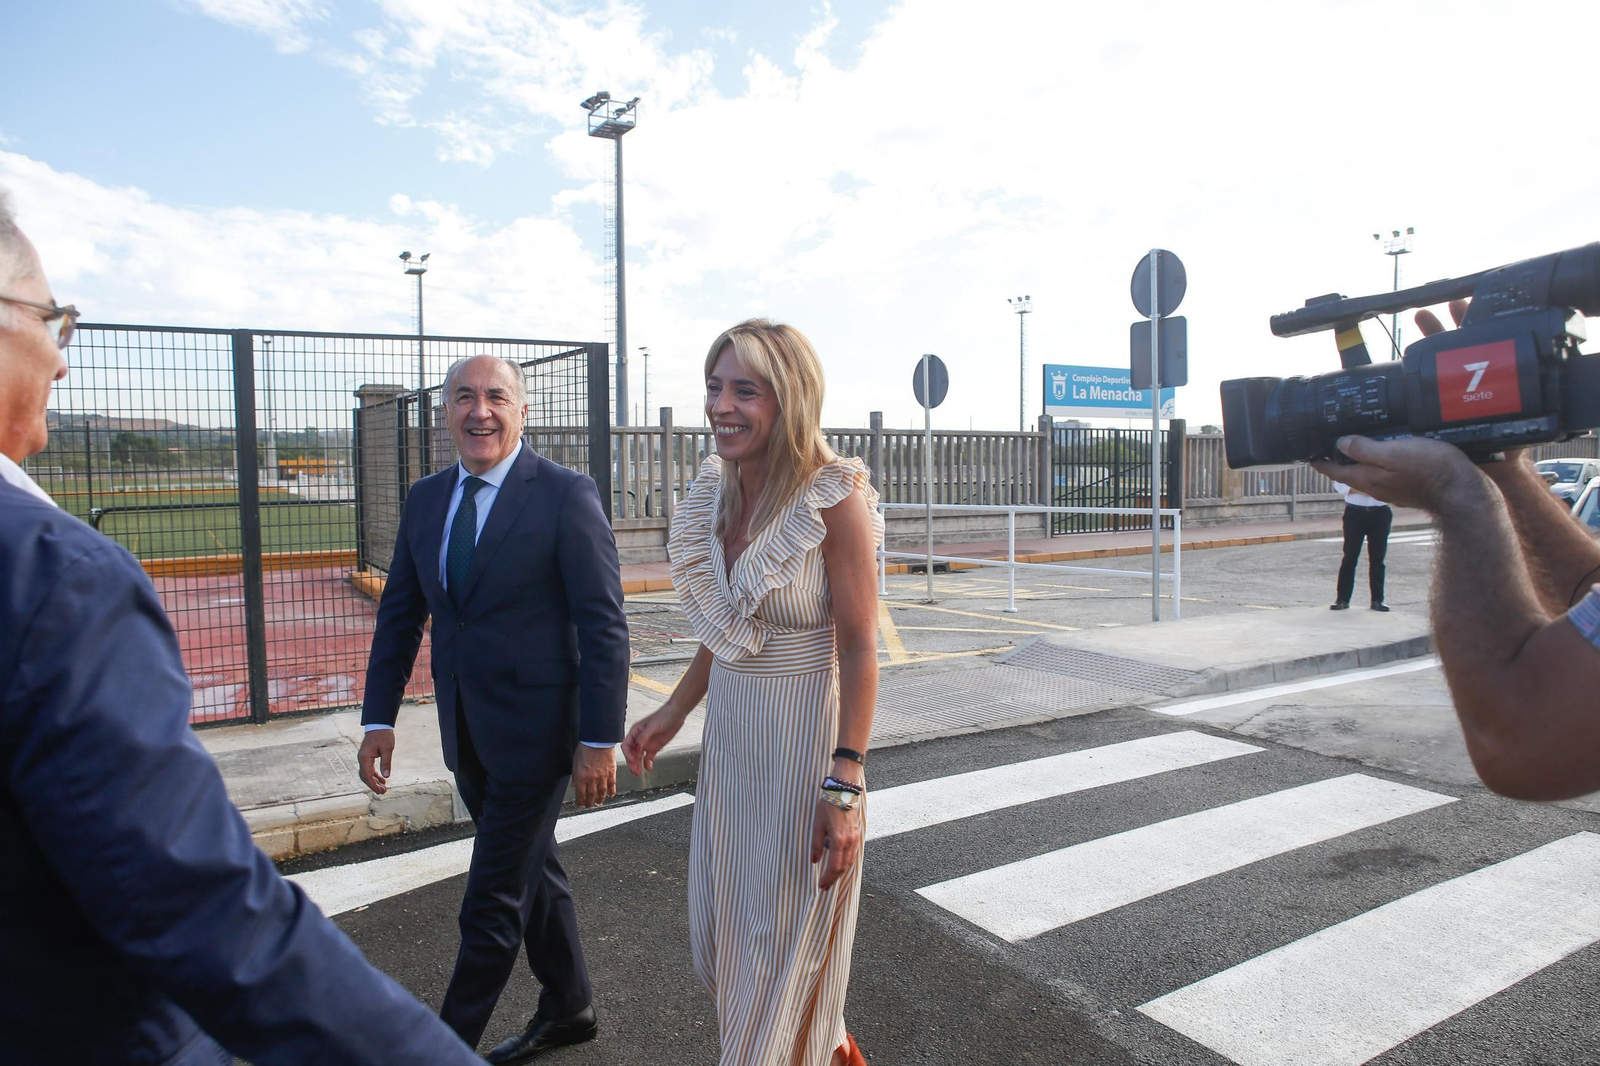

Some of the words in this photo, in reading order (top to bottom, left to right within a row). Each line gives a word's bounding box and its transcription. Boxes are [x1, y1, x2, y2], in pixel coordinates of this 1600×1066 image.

[1072, 374, 1102, 384] Complejo
[1463, 360, 1490, 392] 7
[1072, 385, 1087, 400] La
[1089, 386, 1142, 402] Menacha
[1462, 391, 1493, 403] siete
